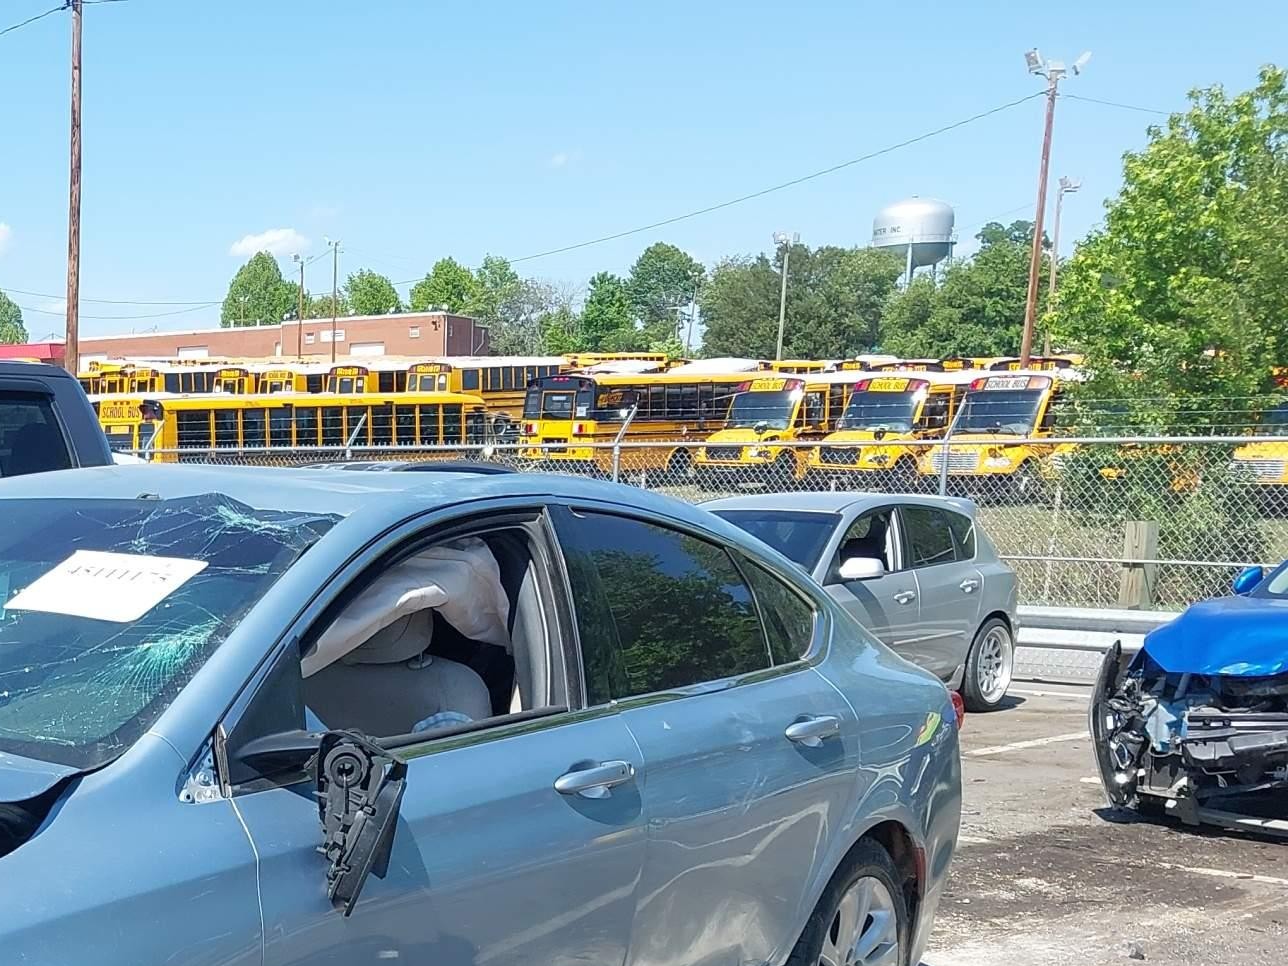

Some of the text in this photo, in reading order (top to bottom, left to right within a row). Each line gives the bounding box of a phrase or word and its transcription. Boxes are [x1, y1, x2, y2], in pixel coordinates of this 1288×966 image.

[752, 382, 771, 390] SCHOOL
[870, 381, 907, 389] SCHOOL BUS
[985, 379, 1027, 389] SCHOOL BUS
[101, 406, 140, 418] SCHOOL BUS
